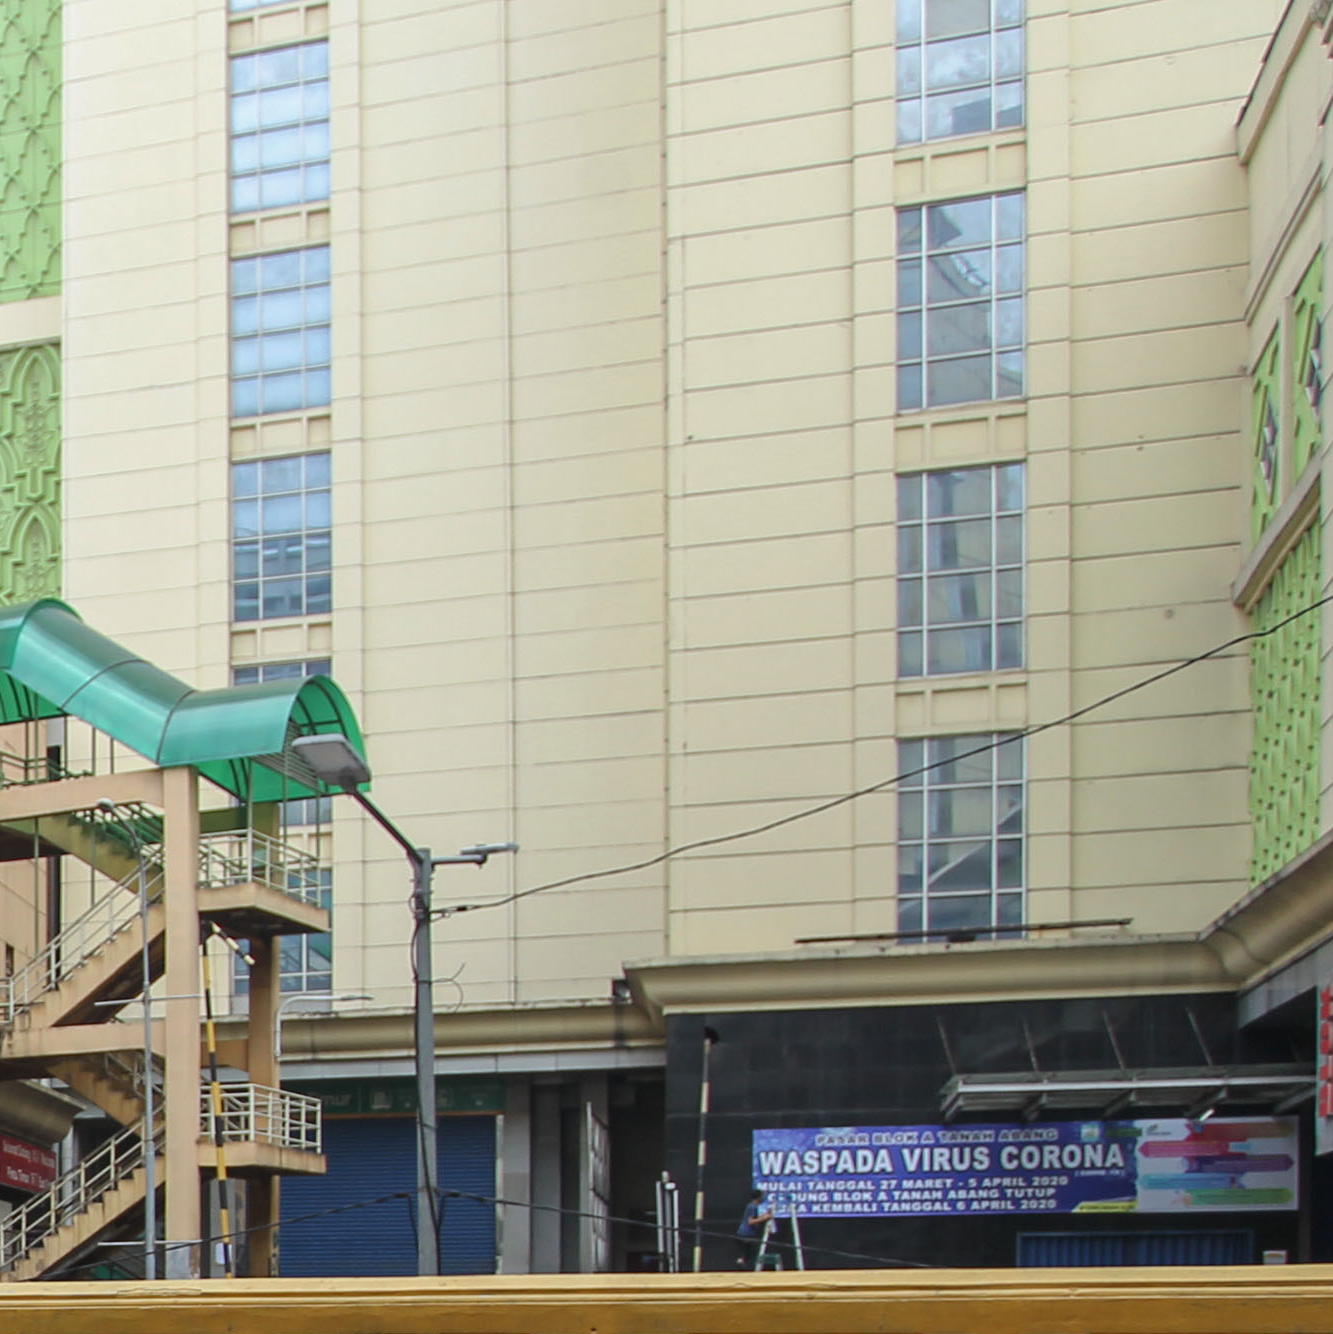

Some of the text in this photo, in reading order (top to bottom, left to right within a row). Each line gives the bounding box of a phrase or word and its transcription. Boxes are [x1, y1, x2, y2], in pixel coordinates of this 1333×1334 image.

[815, 1128, 1058, 1146] PASAR BLOK A TANAH ABANG
[759, 1150, 893, 1175] WASPADA
[901, 1147, 990, 1172] VIRUS
[1000, 1144, 1124, 1170] CORONA
[757, 1180, 802, 1191] MULAI
[807, 1180, 876, 1191] TANGGAL
[880, 1179, 897, 1190] 27
[902, 1178, 954, 1189] MARET
[968, 1178, 977, 1188] 5
[982, 1177, 1027, 1188] APRIL
[1032, 1176, 1068, 1186] 2020
[833, 1191, 872, 1202] BLOK
[877, 1191, 889, 1201] A
[893, 1190, 942, 1201] TANAH
[947, 1188, 1000, 1199] ABANG
[1005, 1187, 1056, 1198] TUTUP
[811, 1202, 877, 1213] KEMBALI
[882, 1201, 952, 1212] TANGGAL
[956, 1200, 966, 1211] 6
[970, 1200, 1016, 1211] APRIL
[1021, 1199, 1057, 1210] 2020
